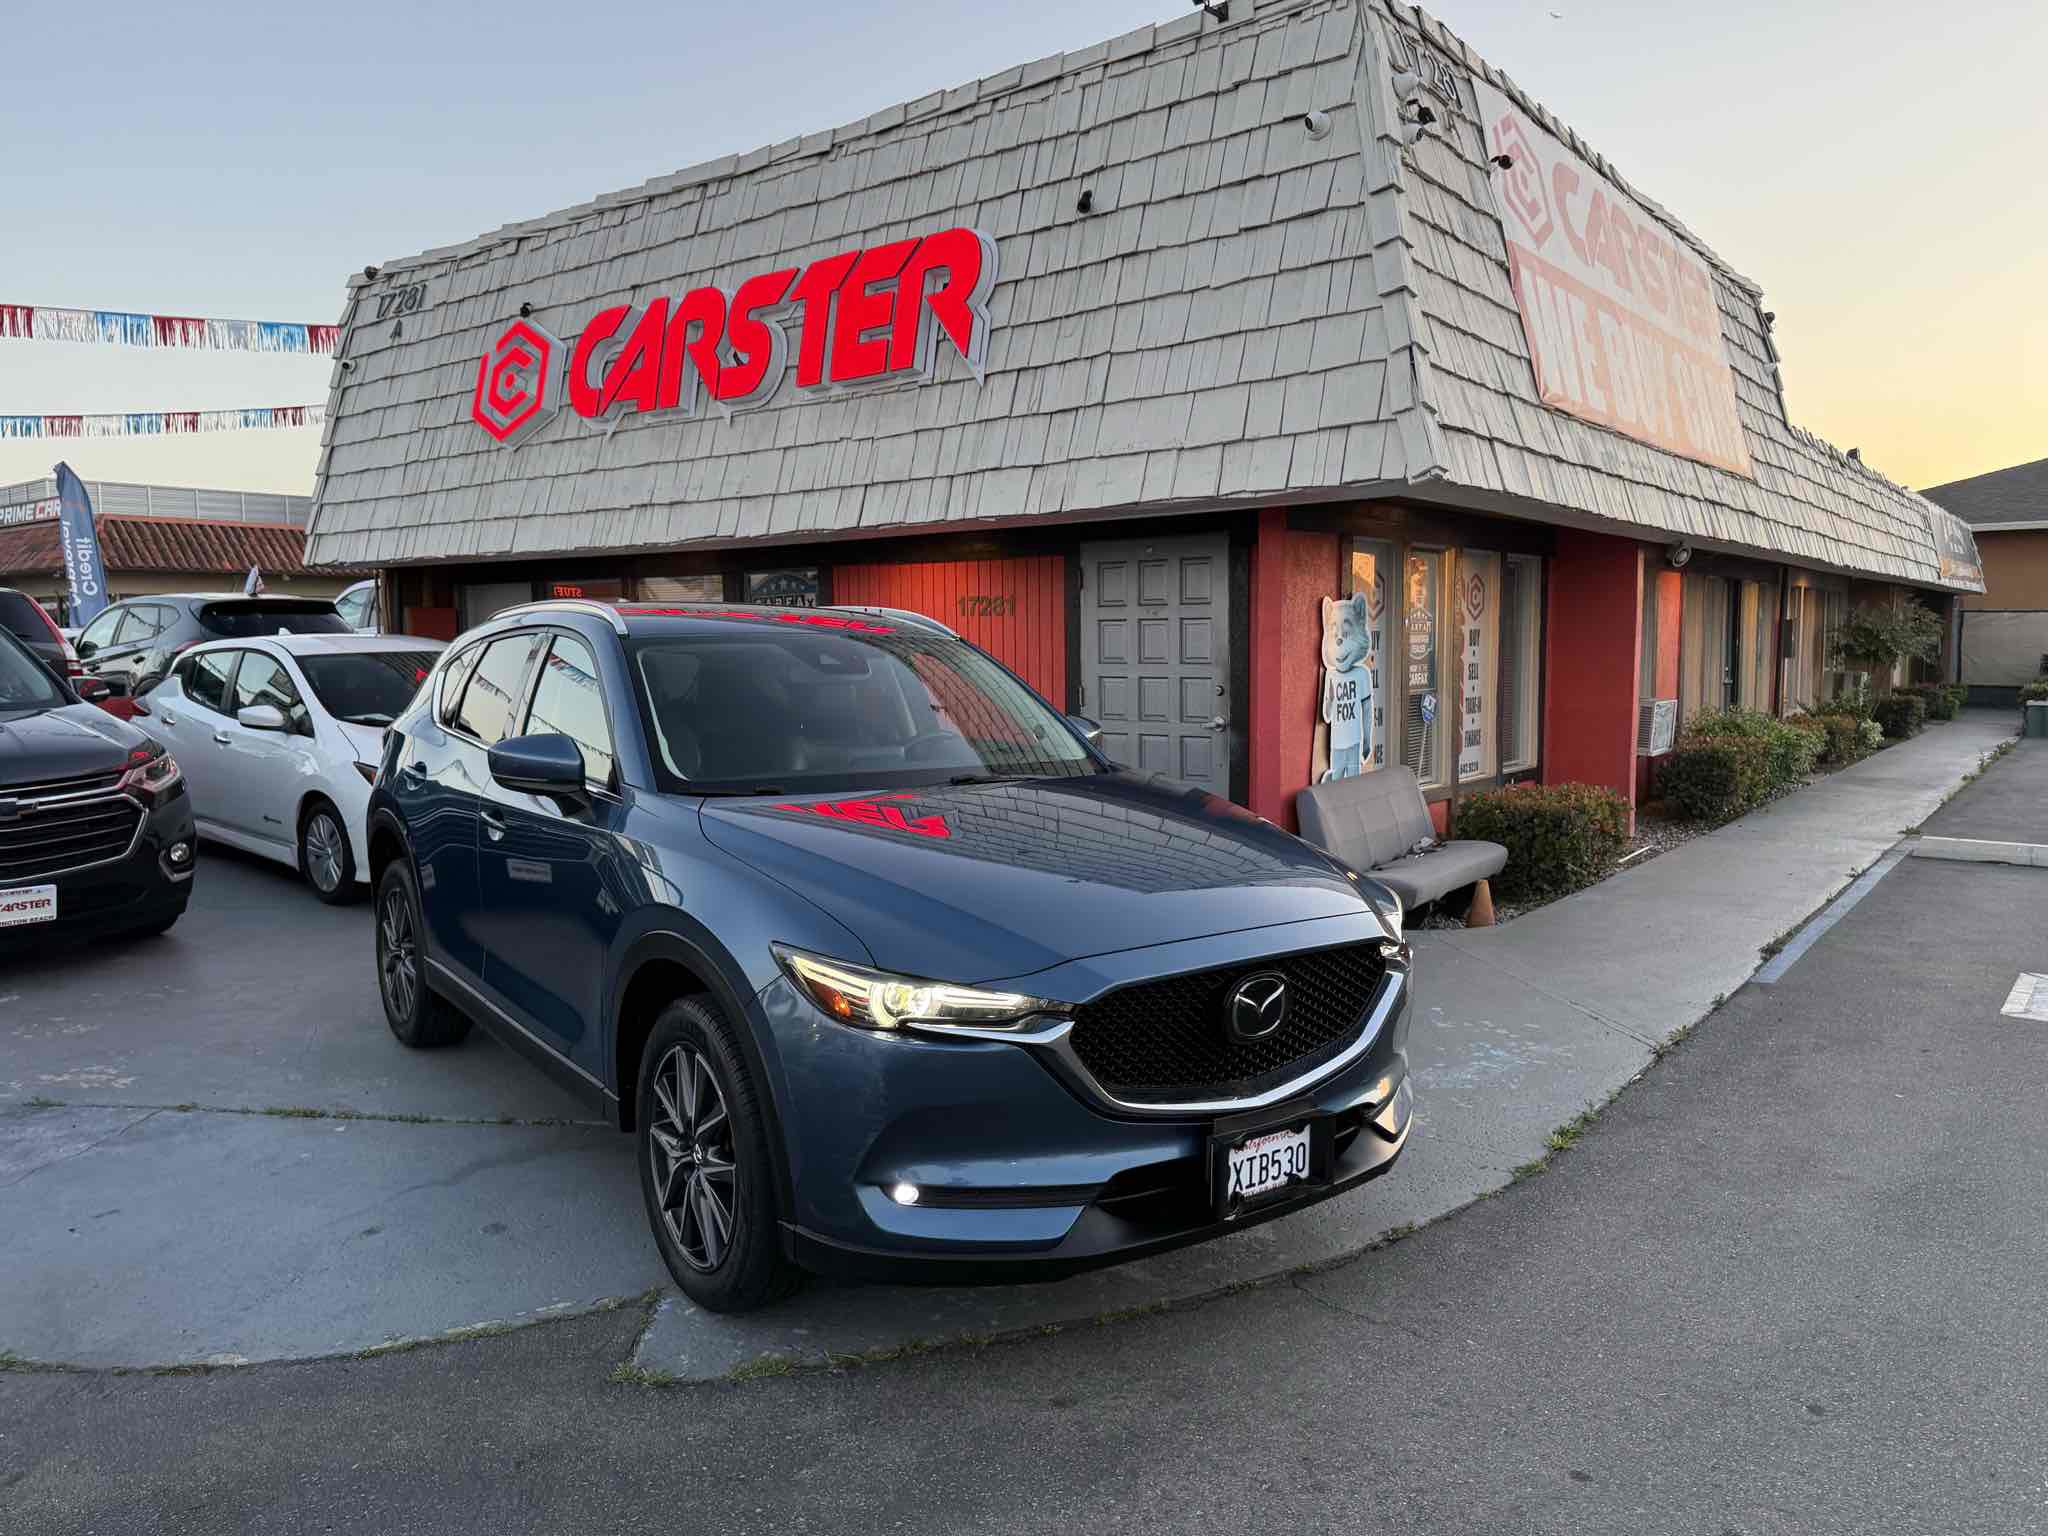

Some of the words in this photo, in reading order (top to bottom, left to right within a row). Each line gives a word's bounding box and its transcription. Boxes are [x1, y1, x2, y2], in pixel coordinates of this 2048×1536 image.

[376, 284, 426, 319] 17281
[568, 227, 990, 418] CARSTER
[959, 594, 1016, 617] 17281
[1469, 629, 1480, 647] BUY
[1468, 663, 1479, 681] SELL
[1336, 680, 1357, 701] CAR
[1336, 702, 1356, 721] FOX
[1232, 1142, 1306, 1192] XIB530
